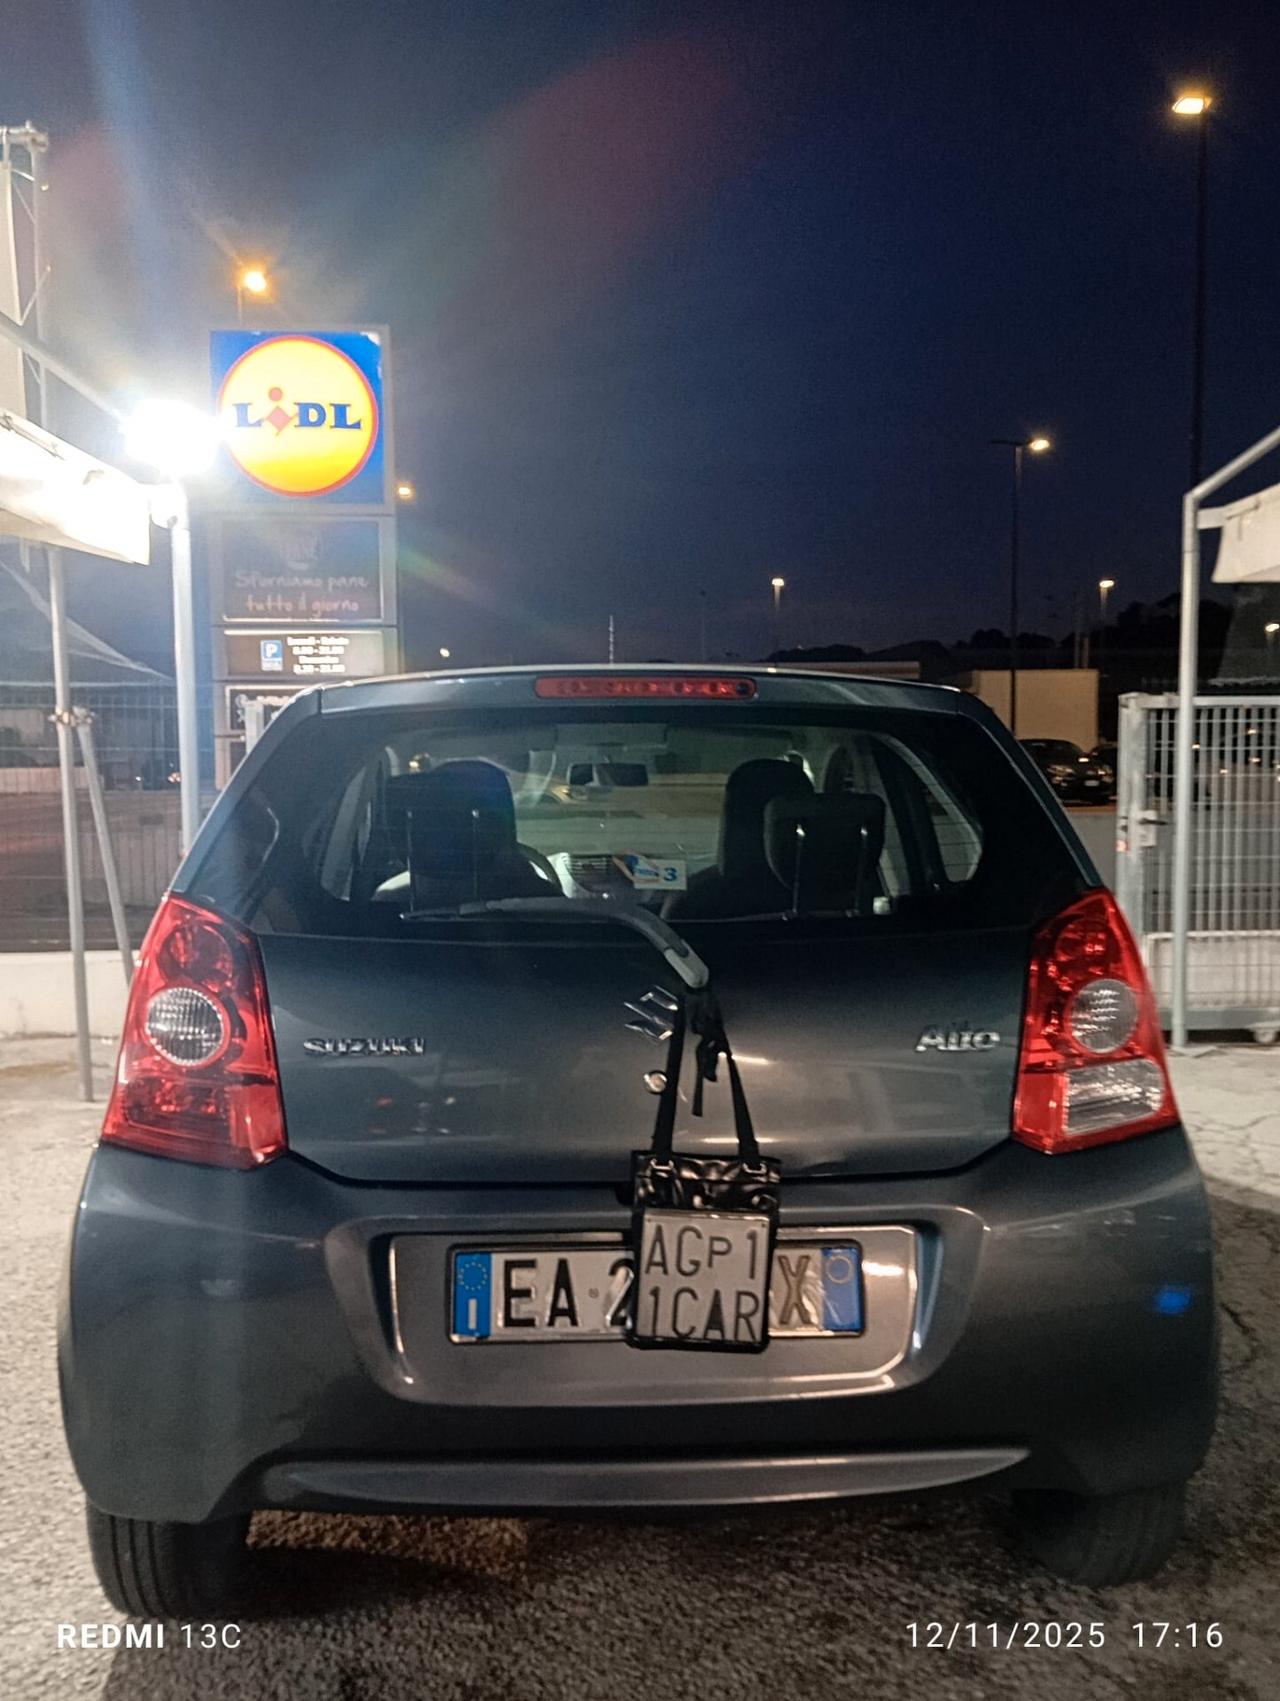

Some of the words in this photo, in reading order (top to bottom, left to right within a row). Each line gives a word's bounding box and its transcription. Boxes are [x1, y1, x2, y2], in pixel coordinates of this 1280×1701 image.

[327, 576, 368, 591] pane
[246, 593, 293, 612] tutto
[312, 597, 359, 618] giorno
[265, 643, 278, 658] P
[303, 1037, 425, 1056] SUZUKI
[916, 1024, 1000, 1052] Alto
